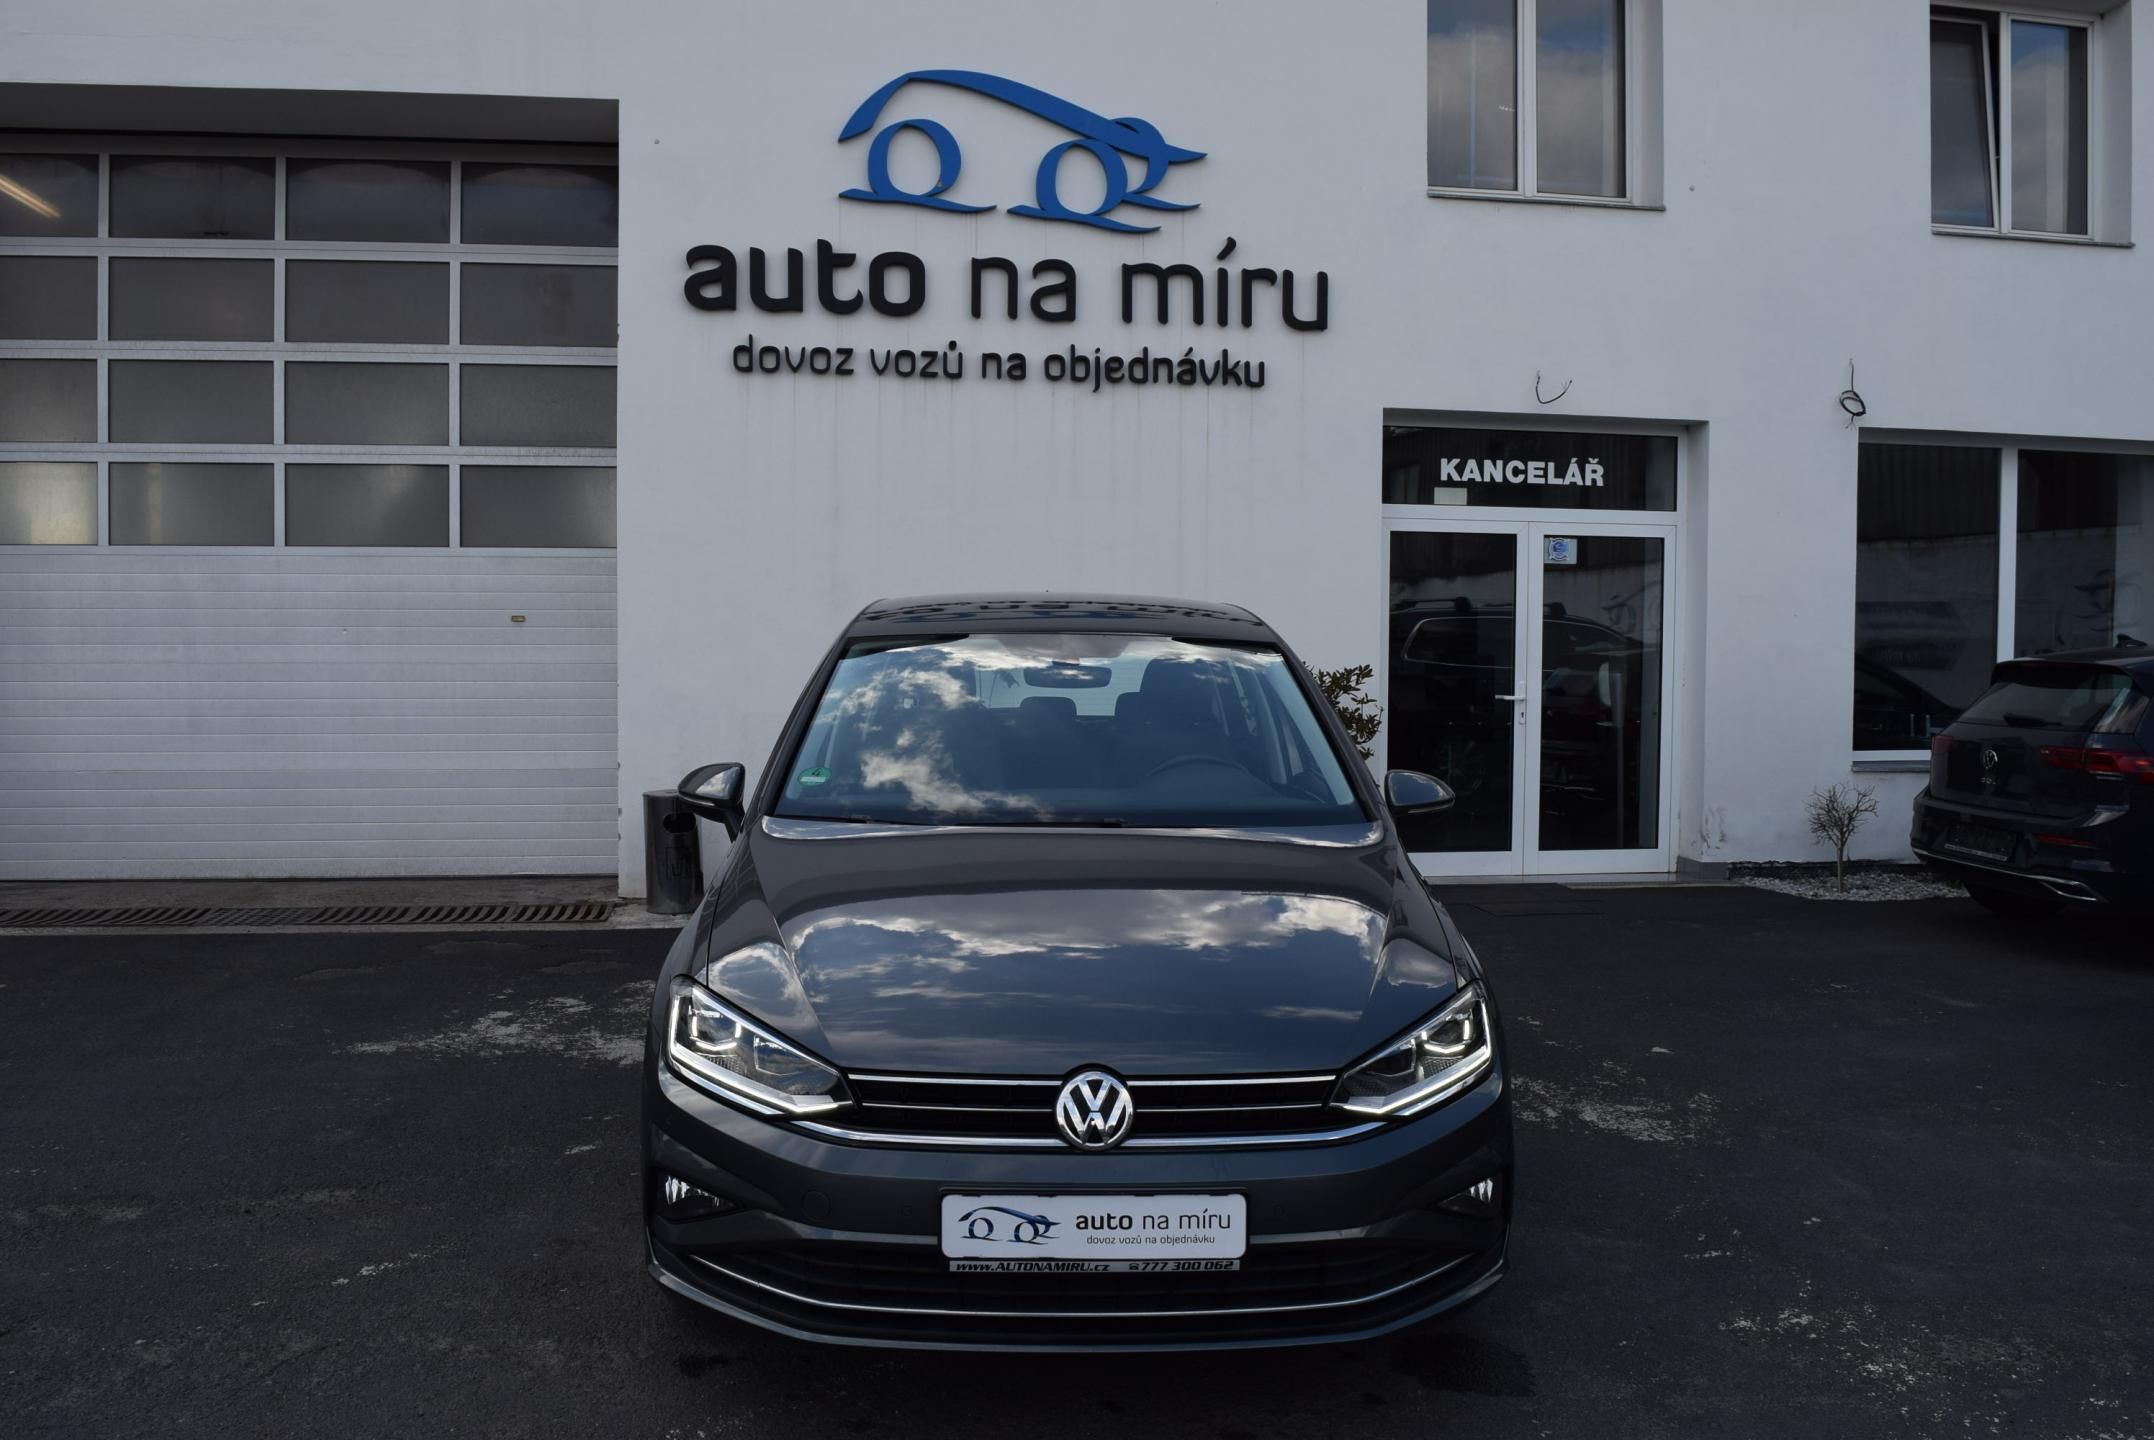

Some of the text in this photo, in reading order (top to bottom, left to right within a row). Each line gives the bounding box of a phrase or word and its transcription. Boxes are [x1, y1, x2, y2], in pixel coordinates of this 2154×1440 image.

[683, 236, 1329, 332] auto na míru
[732, 334, 1265, 394] dovoz vozů na objednávku
[1440, 457, 1605, 487] KANCELÁŘ
[1075, 1208, 1231, 1230] auto na míru
[1086, 1234, 1216, 1247] dovoz vozů na objednávku
[1141, 1261, 1168, 1272] 777
[1172, 1261, 1203, 1271] 300
[1206, 1260, 1234, 1271] 062
